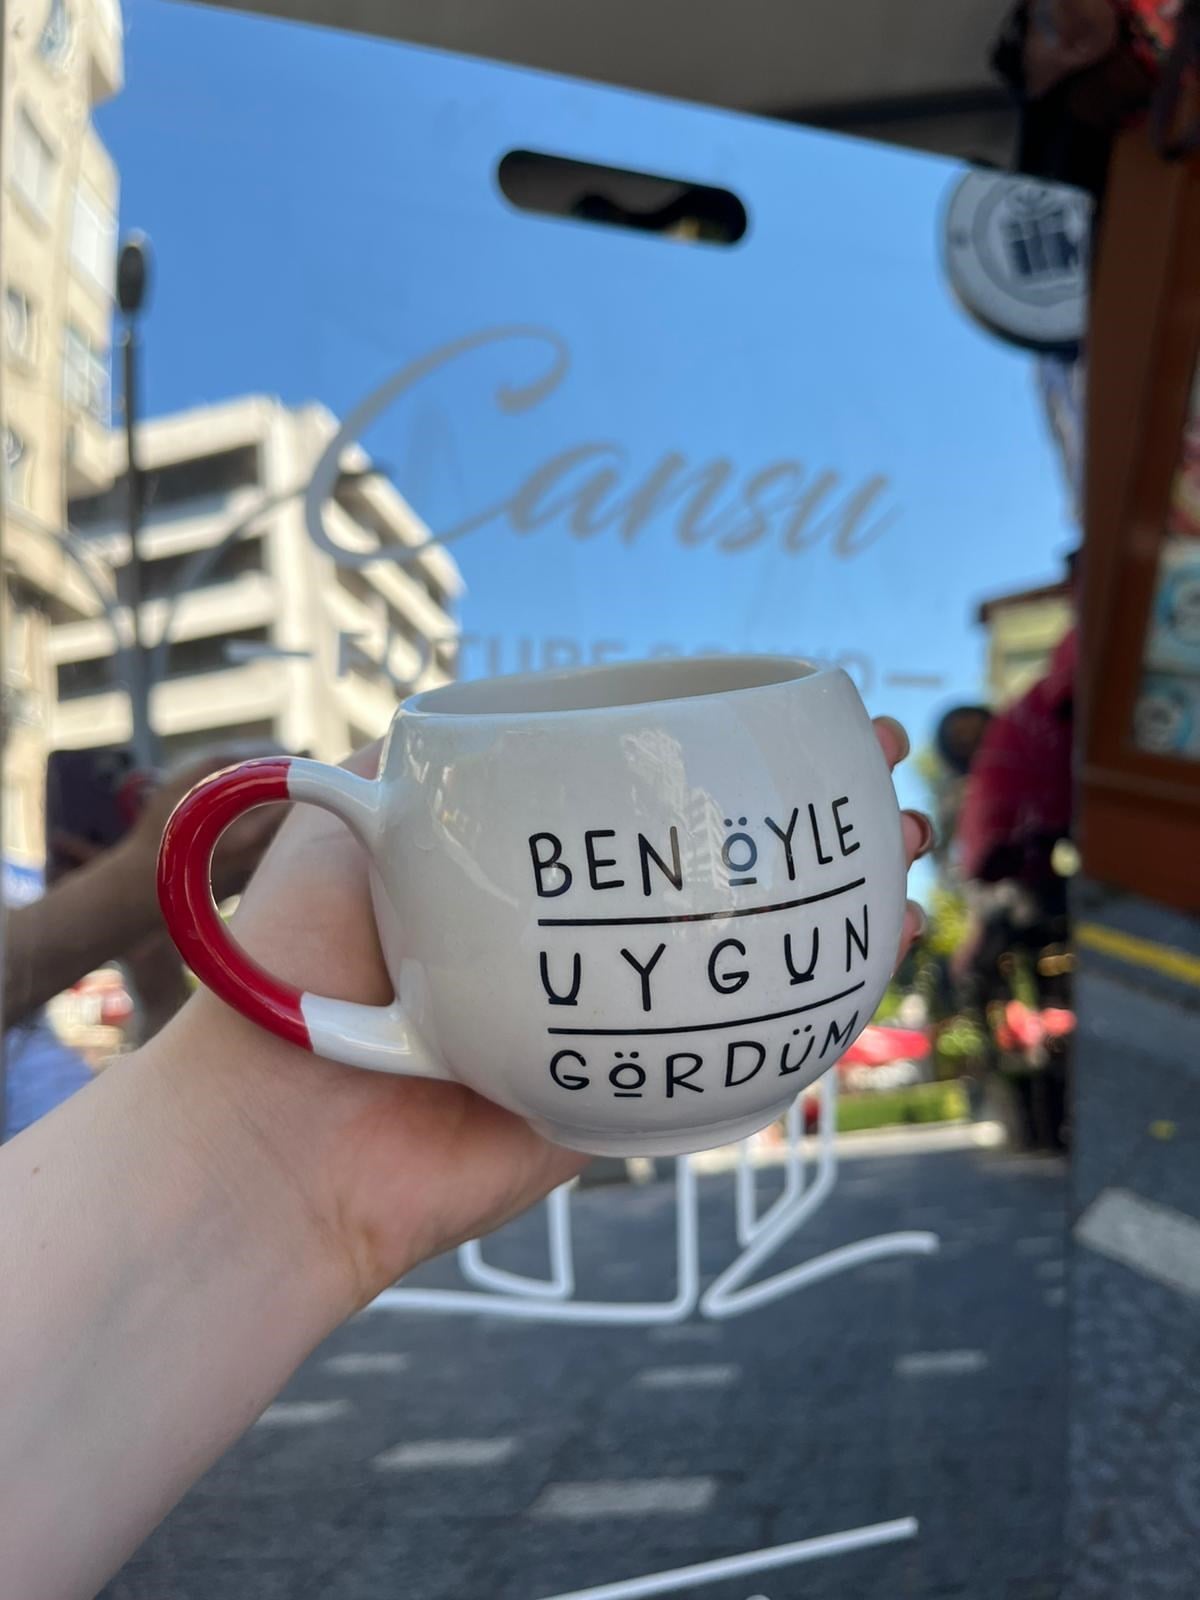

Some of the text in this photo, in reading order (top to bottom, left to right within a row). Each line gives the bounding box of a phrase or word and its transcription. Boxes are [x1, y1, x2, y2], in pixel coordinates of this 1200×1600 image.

[305, 324, 895, 562] Cansu
[528, 796, 861, 898] BEN ÖYLE
[539, 904, 869, 1012] UYGUN
[549, 1011, 859, 1098] GÖRDÜM
